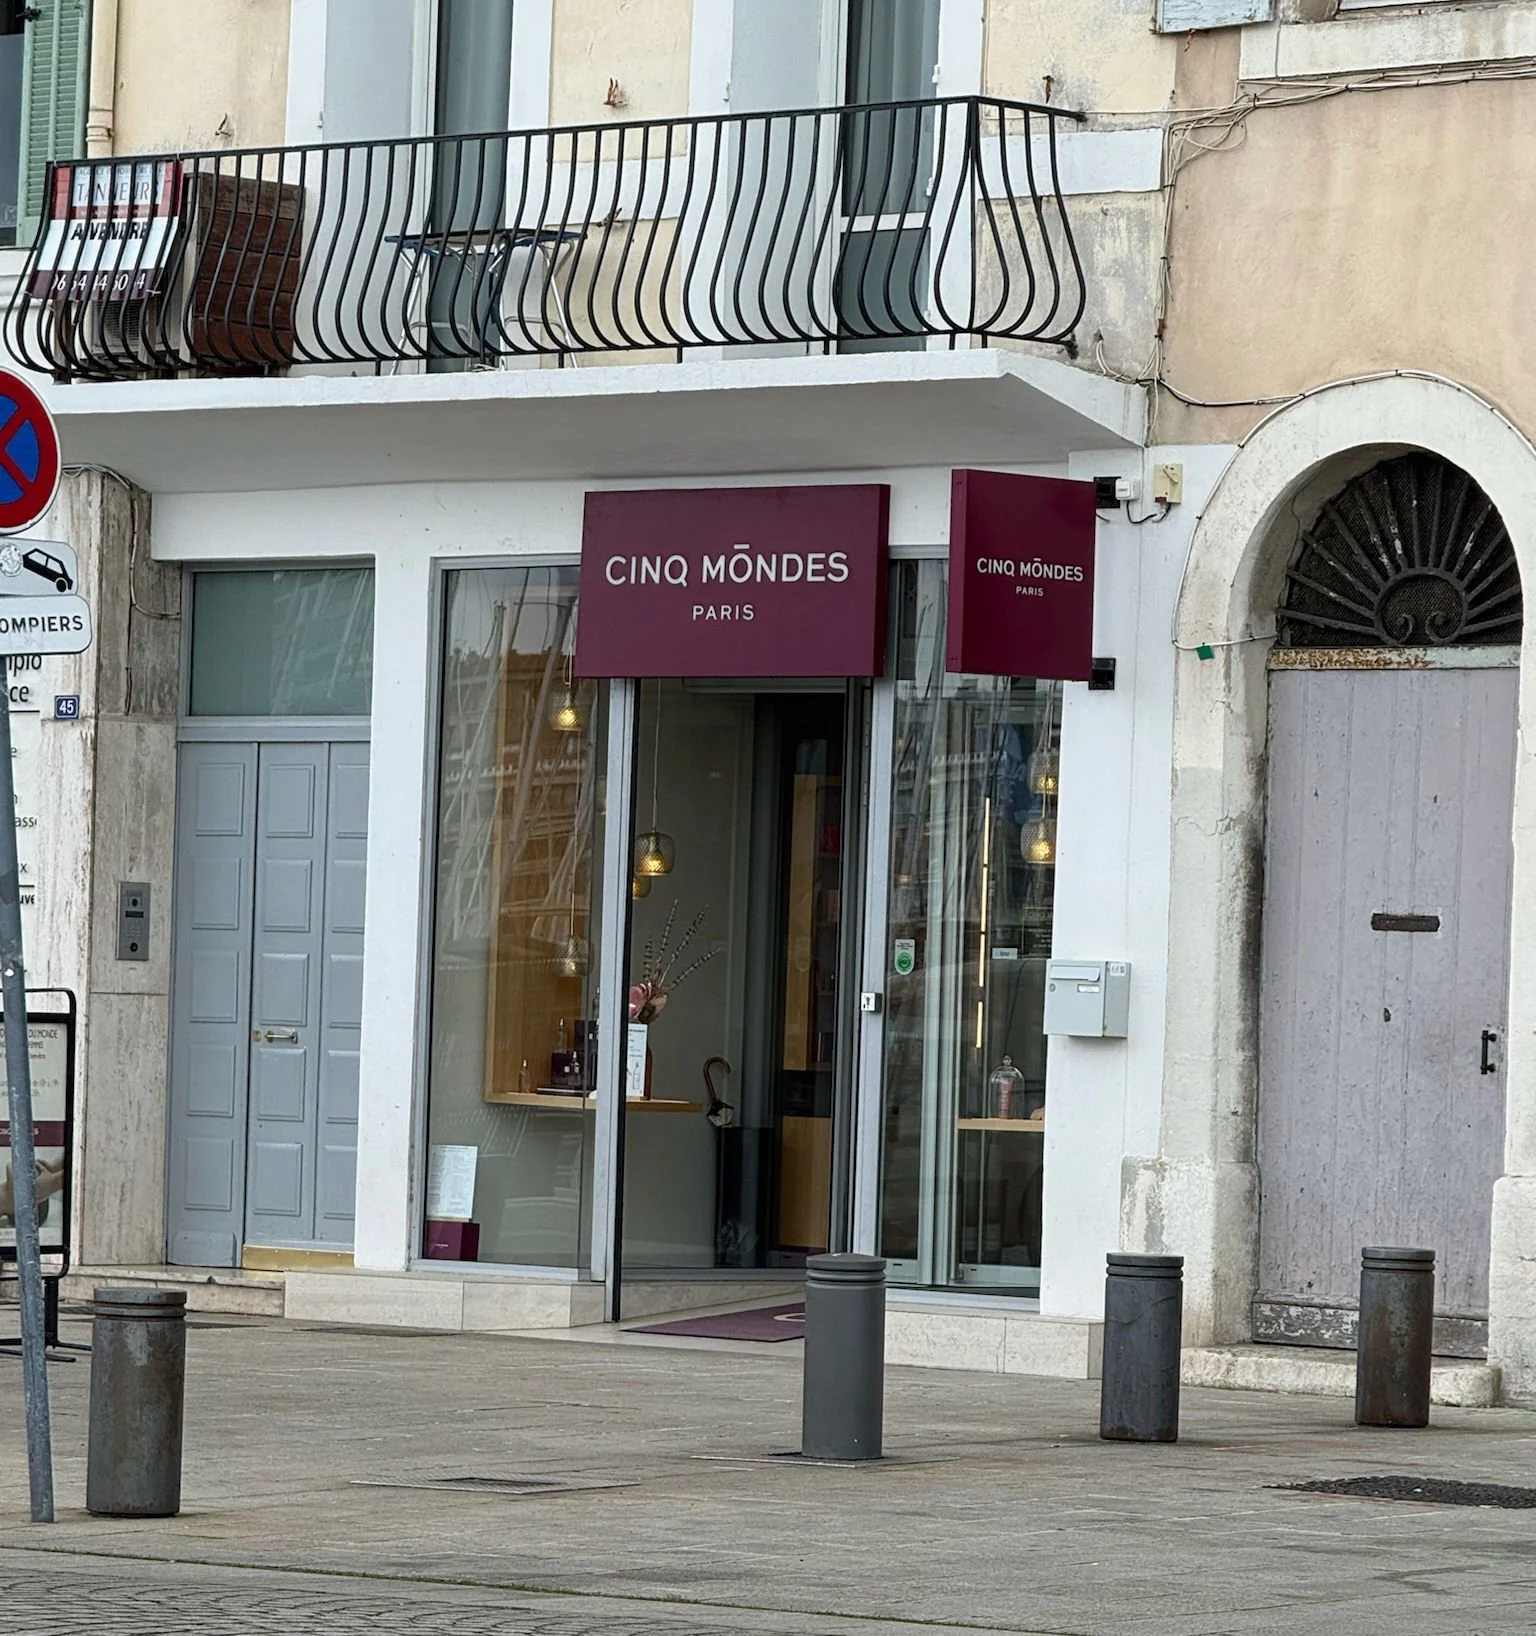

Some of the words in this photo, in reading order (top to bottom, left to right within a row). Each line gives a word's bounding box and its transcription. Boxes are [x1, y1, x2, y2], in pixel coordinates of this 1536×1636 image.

[605, 554, 688, 587] CINQ
[701, 543, 849, 584] MŌNDES
[976, 557, 1015, 577] CINQ
[1015, 586, 1044, 597] PARIS
[692, 604, 754, 621] PARIS
[59, 700, 74, 714] 45
